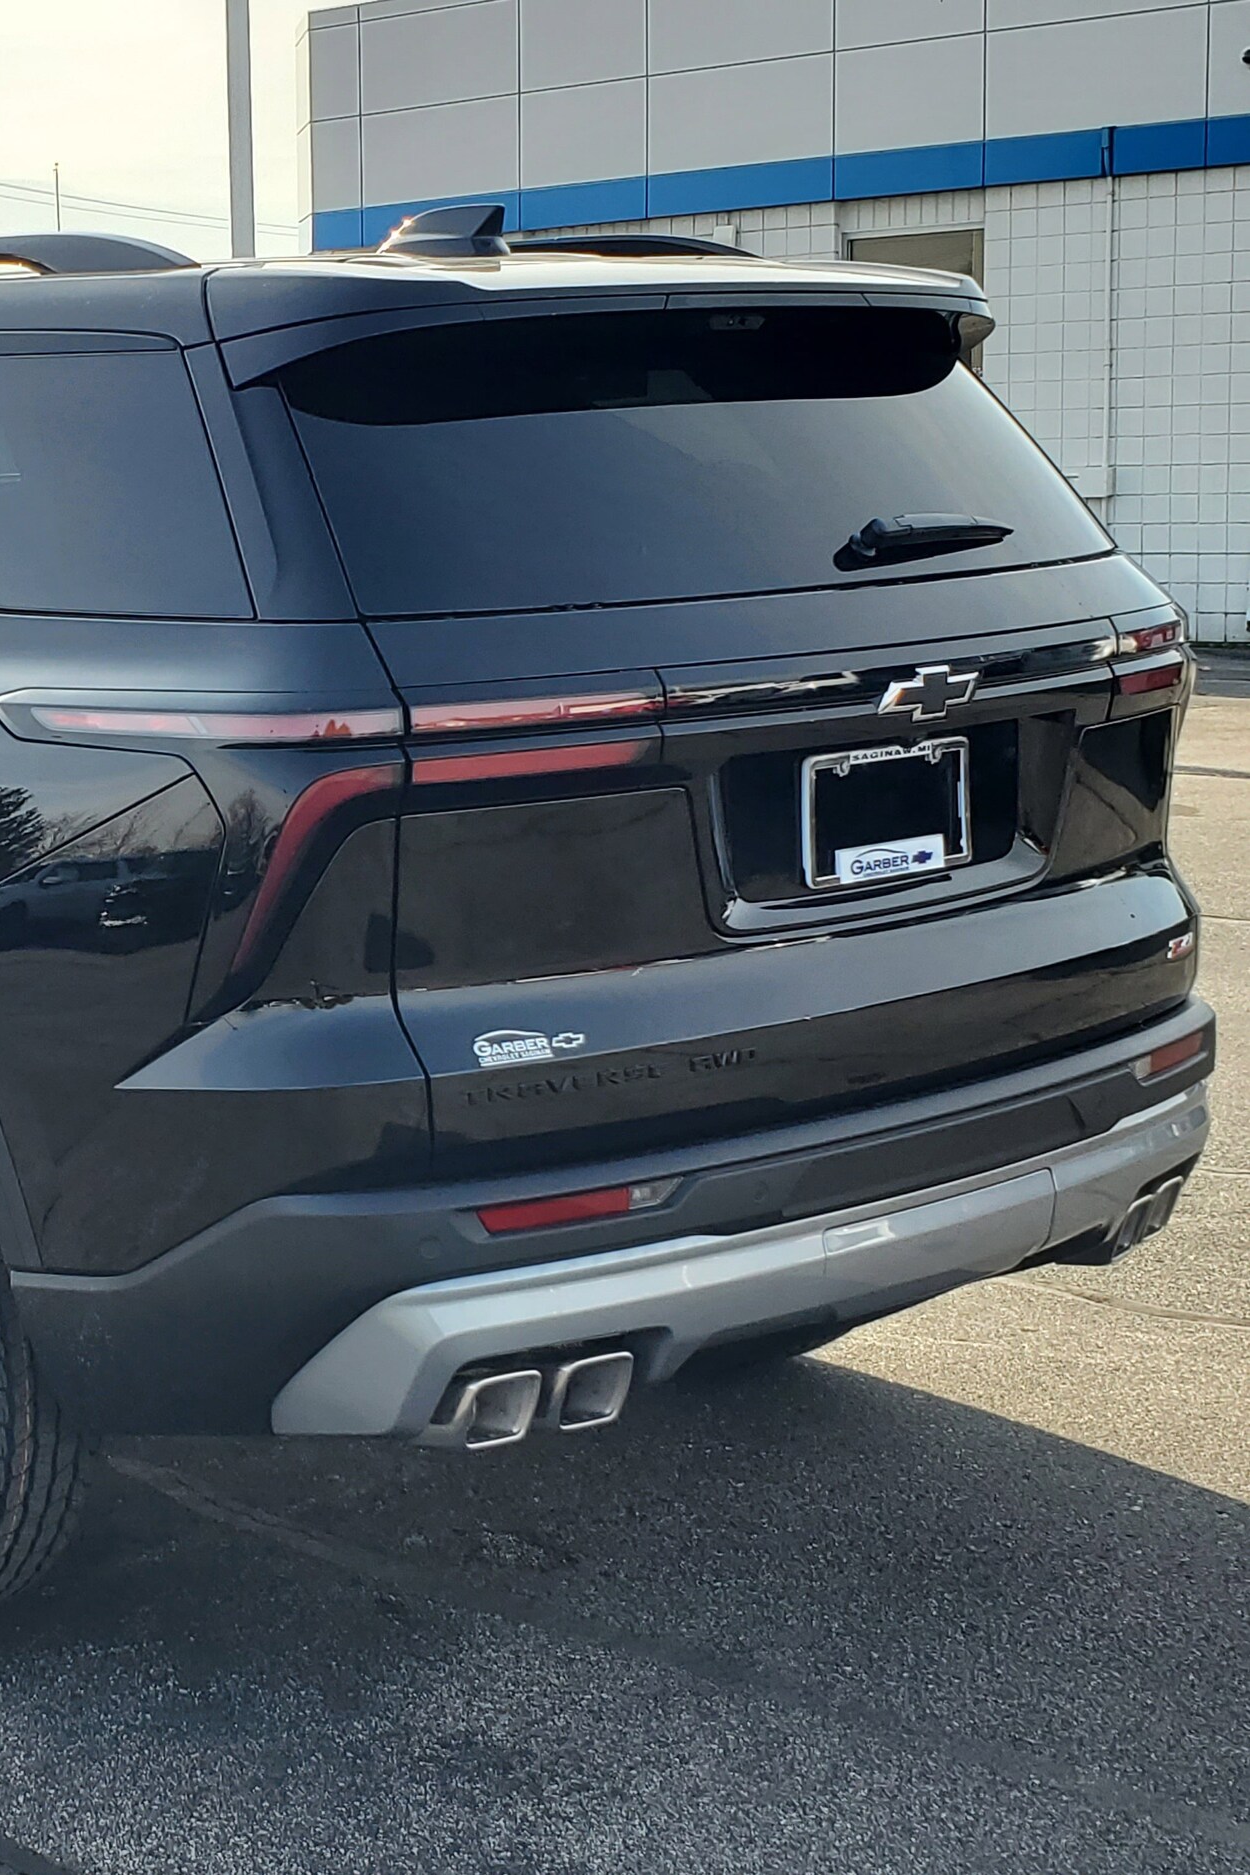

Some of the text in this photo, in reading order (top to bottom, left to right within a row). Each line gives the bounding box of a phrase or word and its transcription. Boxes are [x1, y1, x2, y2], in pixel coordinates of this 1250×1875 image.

[850, 854, 911, 875] GARBER
[473, 1036, 550, 1056] GARBER
[464, 1064, 661, 1105] TRAVERSE
